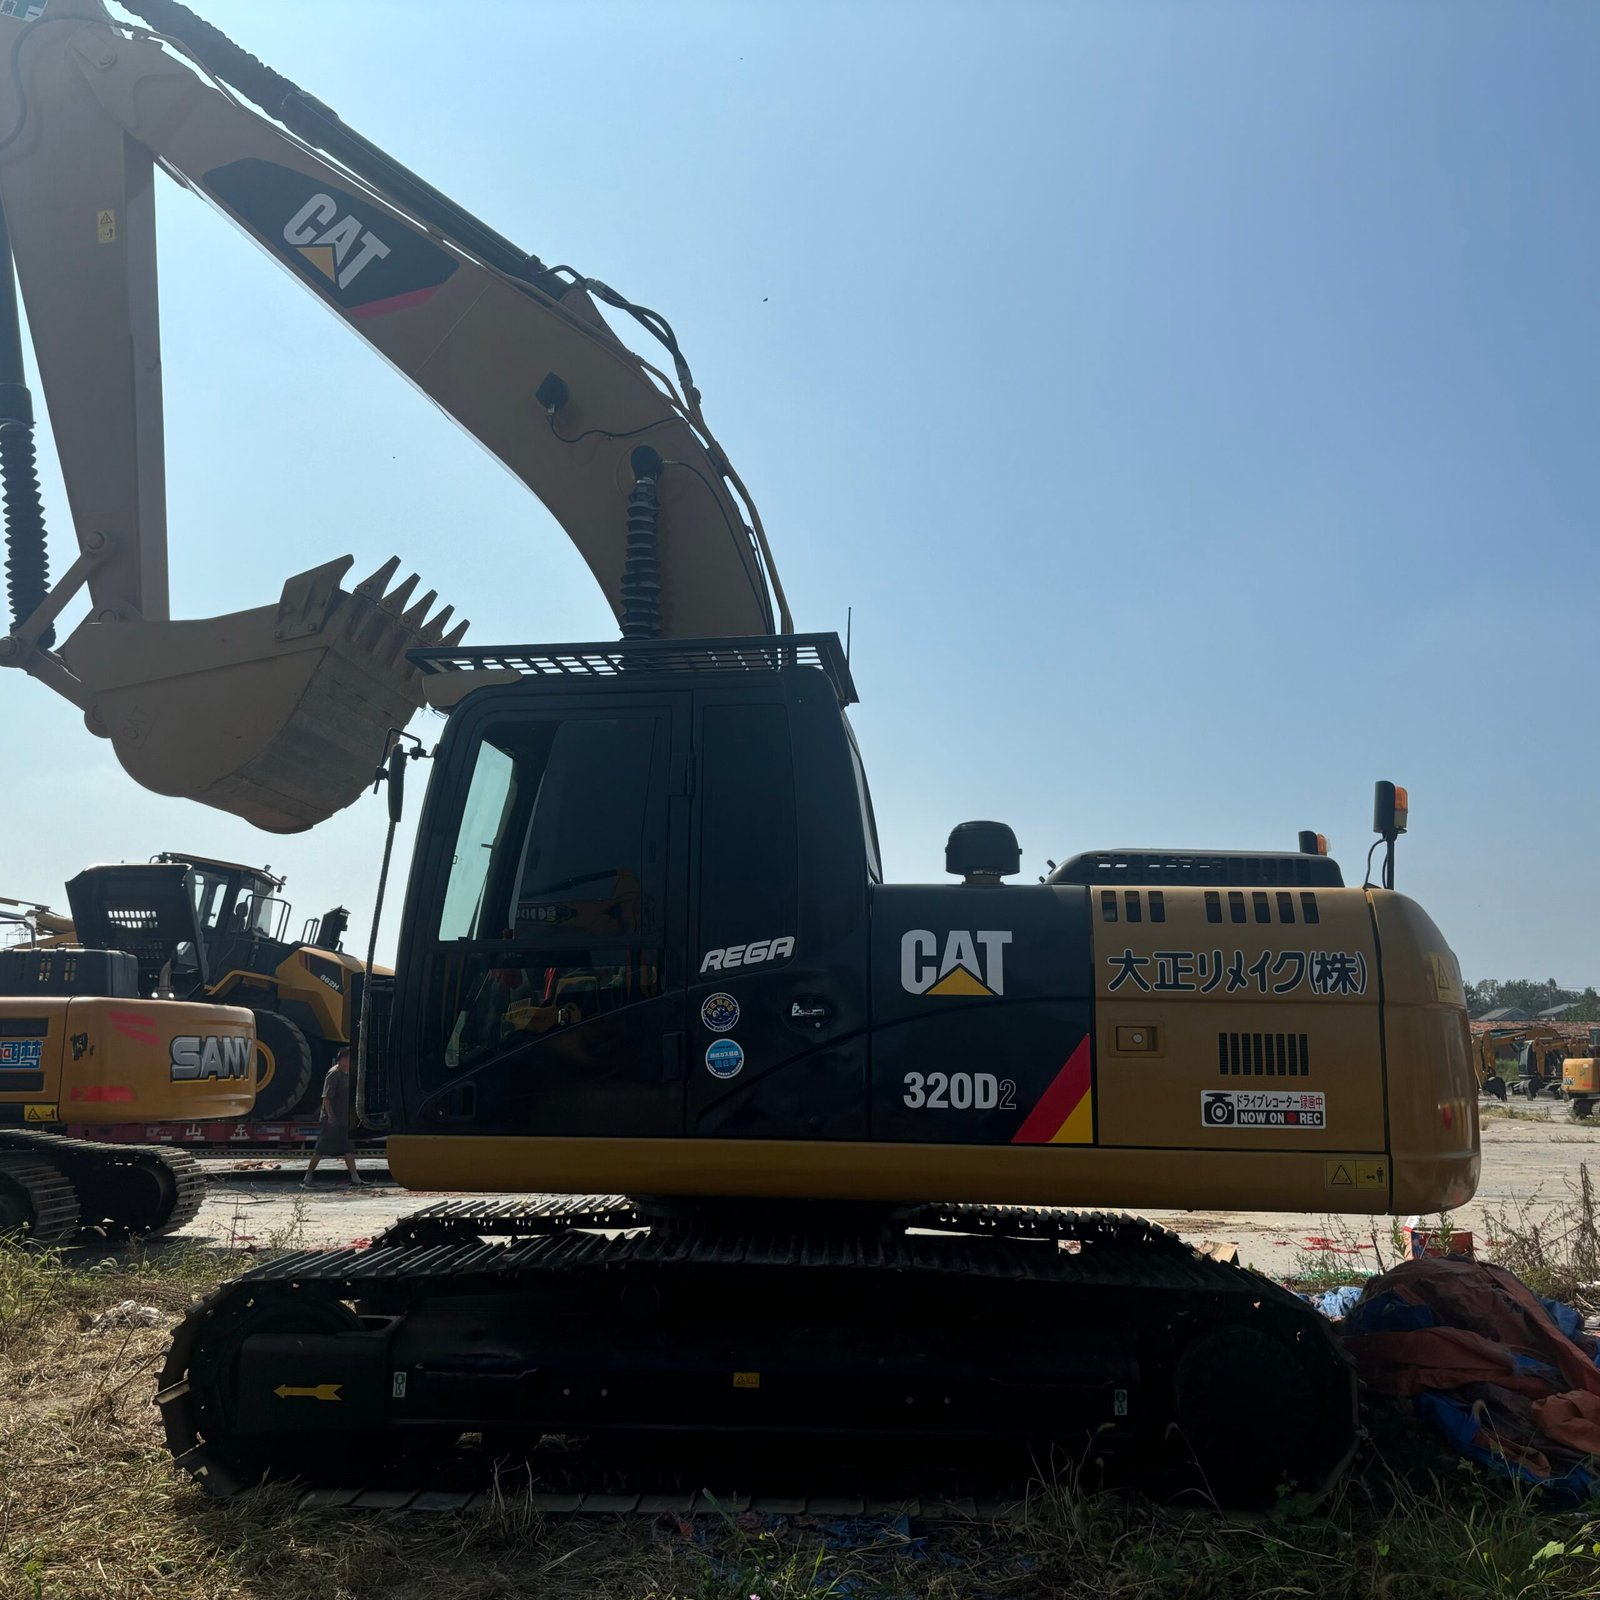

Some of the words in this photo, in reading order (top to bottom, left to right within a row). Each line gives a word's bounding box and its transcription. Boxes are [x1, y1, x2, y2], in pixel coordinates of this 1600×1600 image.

[283, 193, 391, 290] CAT
[699, 935, 796, 974] REGA
[901, 929, 1013, 996] CAT
[1107, 948, 1368, 995] 大正リメイク(株)
[170, 1035, 252, 1082] SANY
[903, 1071, 1017, 1110] 320D2
[1240, 1112, 1267, 1124] NOW
[1269, 1112, 1285, 1124] ON
[1299, 1113, 1321, 1125] REC
